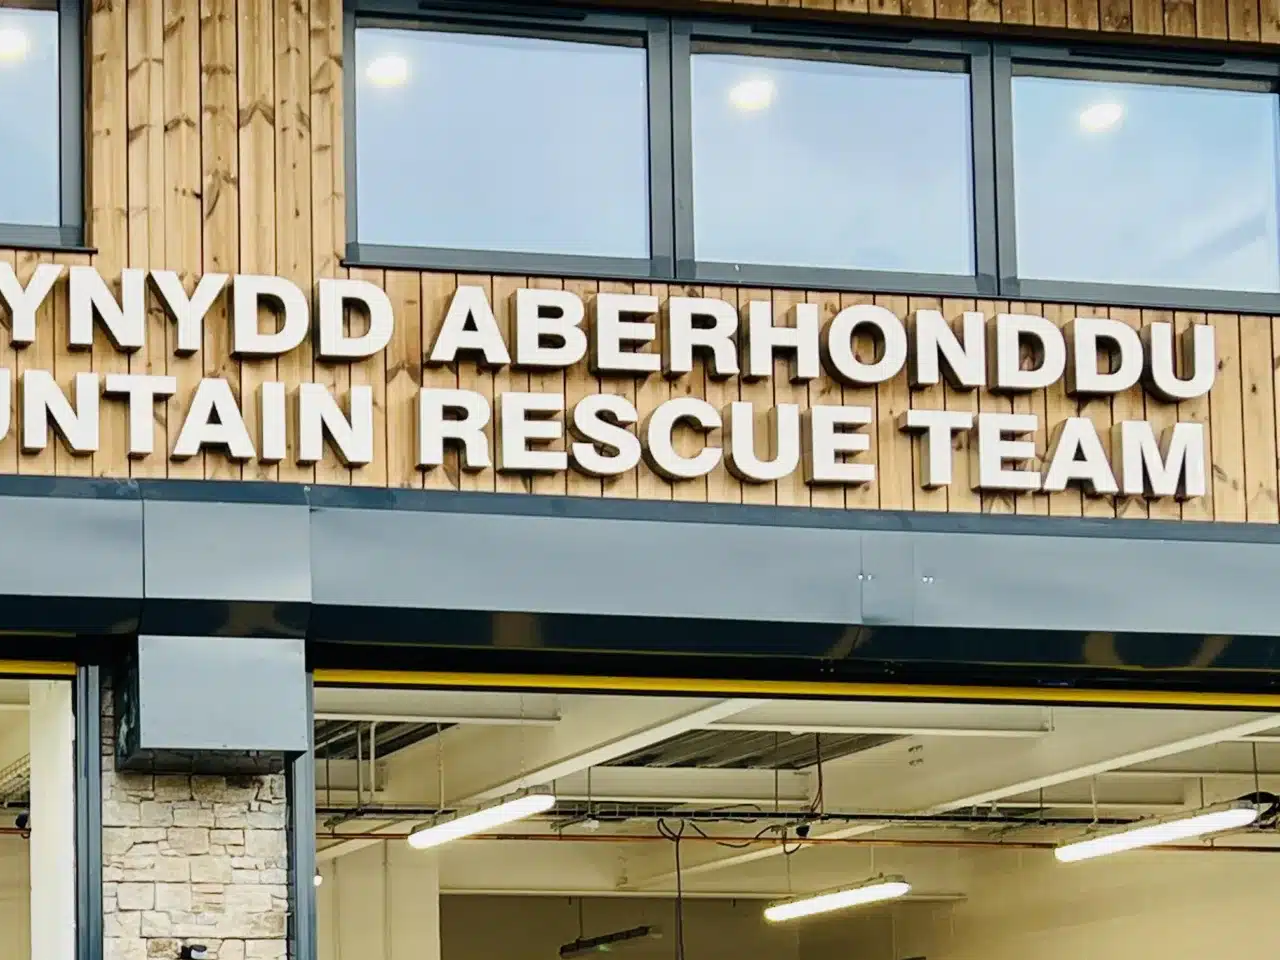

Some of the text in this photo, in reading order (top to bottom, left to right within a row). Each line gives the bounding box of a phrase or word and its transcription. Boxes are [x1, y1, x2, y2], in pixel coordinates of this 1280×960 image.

[430, 285, 1216, 400] ABERHONDDU
[415, 387, 877, 486] RESCUE
[897, 409, 1206, 498] TEAM
